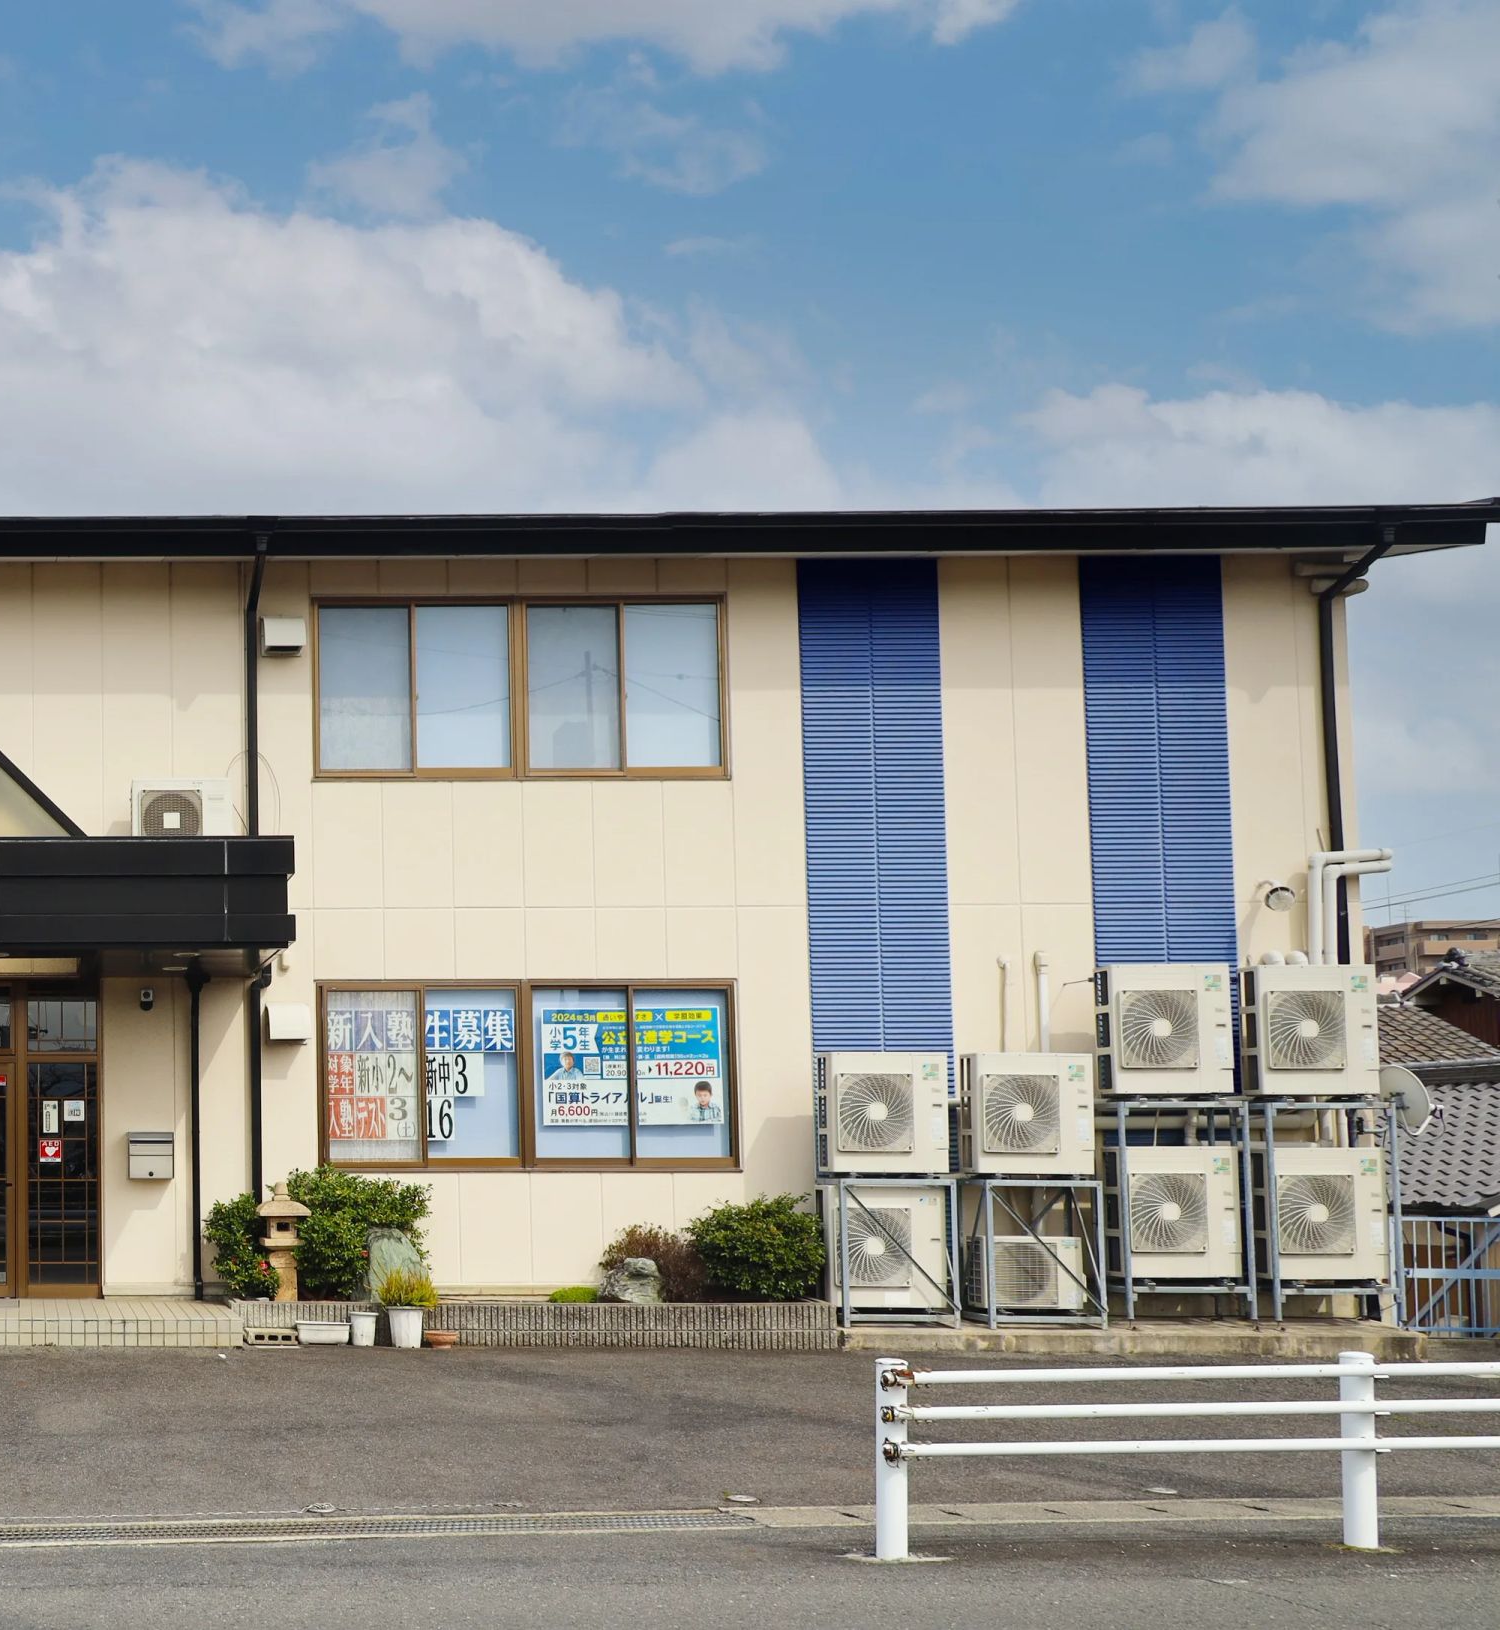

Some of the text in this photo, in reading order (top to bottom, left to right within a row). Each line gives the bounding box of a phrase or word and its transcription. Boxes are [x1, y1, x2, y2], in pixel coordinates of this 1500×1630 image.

[551, 1013, 596, 1022] 2024年3月
[328, 1010, 513, 1051] 新入塾生募集
[328, 1056, 353, 1072] 対象
[655, 1061, 715, 1076] 11,220円
[328, 1075, 353, 1094] 学年
[389, 1098, 408, 1121] 3
[427, 1099, 454, 1139] 16
